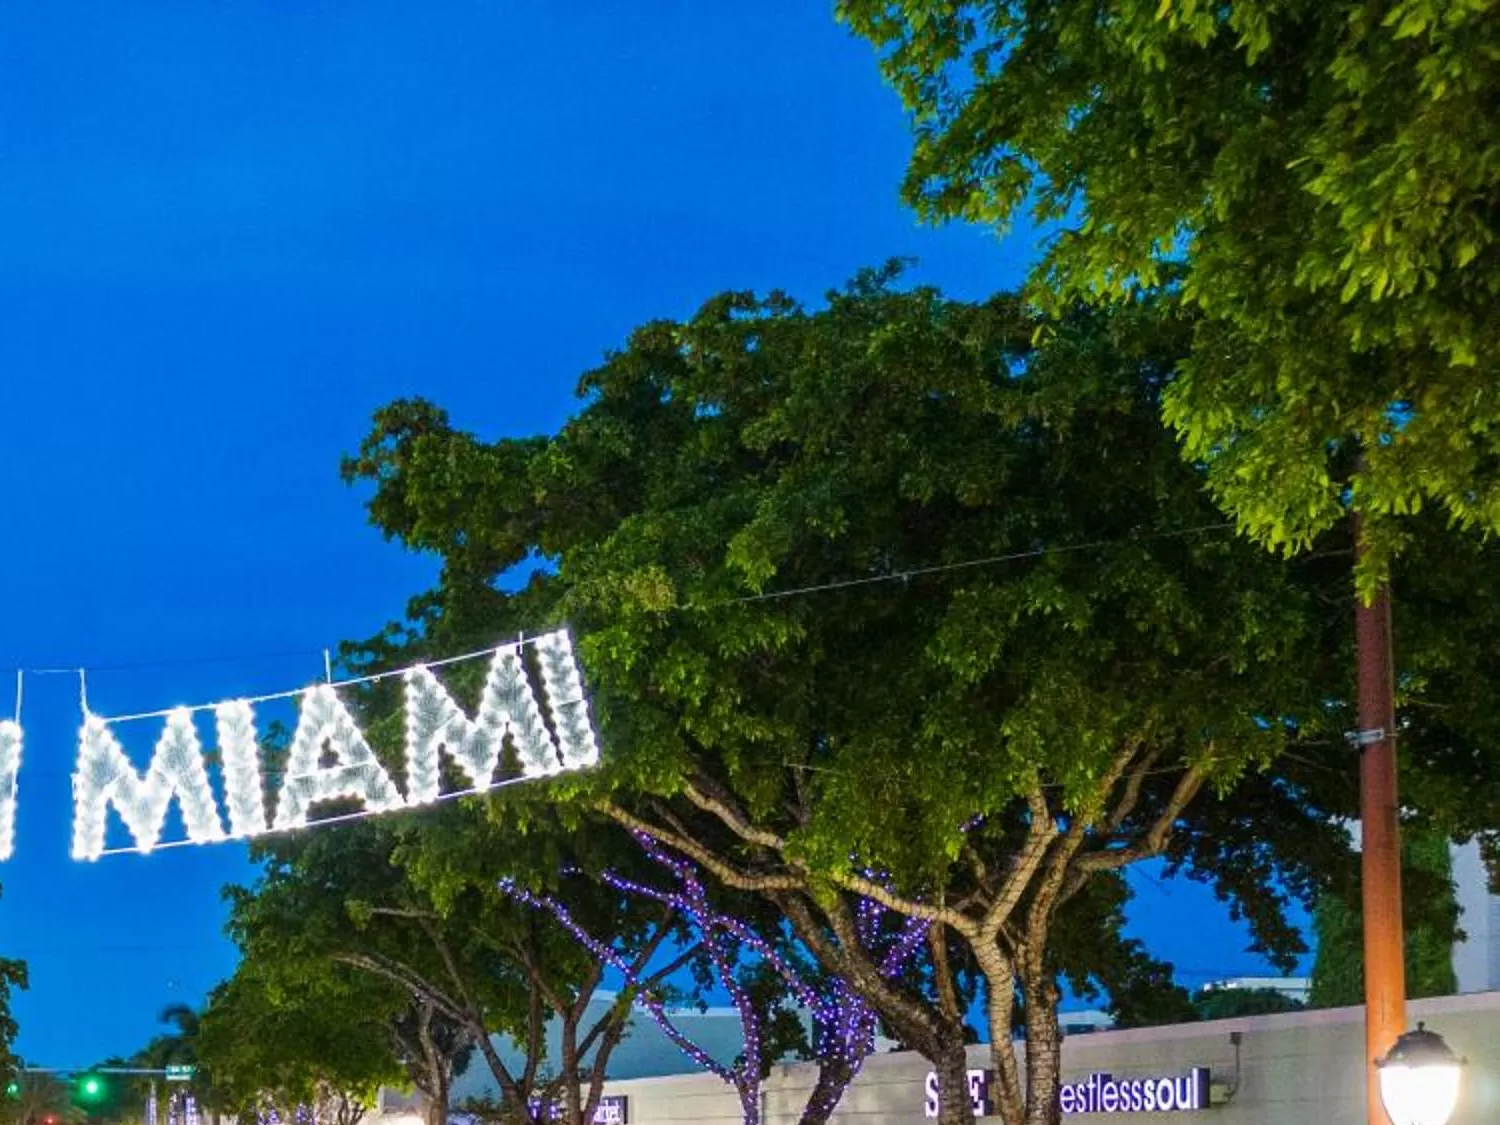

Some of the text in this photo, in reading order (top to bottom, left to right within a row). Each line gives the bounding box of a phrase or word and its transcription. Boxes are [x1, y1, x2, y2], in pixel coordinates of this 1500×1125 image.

[71, 628, 599, 860] MIAMI
[925, 1067, 1199, 1117] SE estlesssoul
